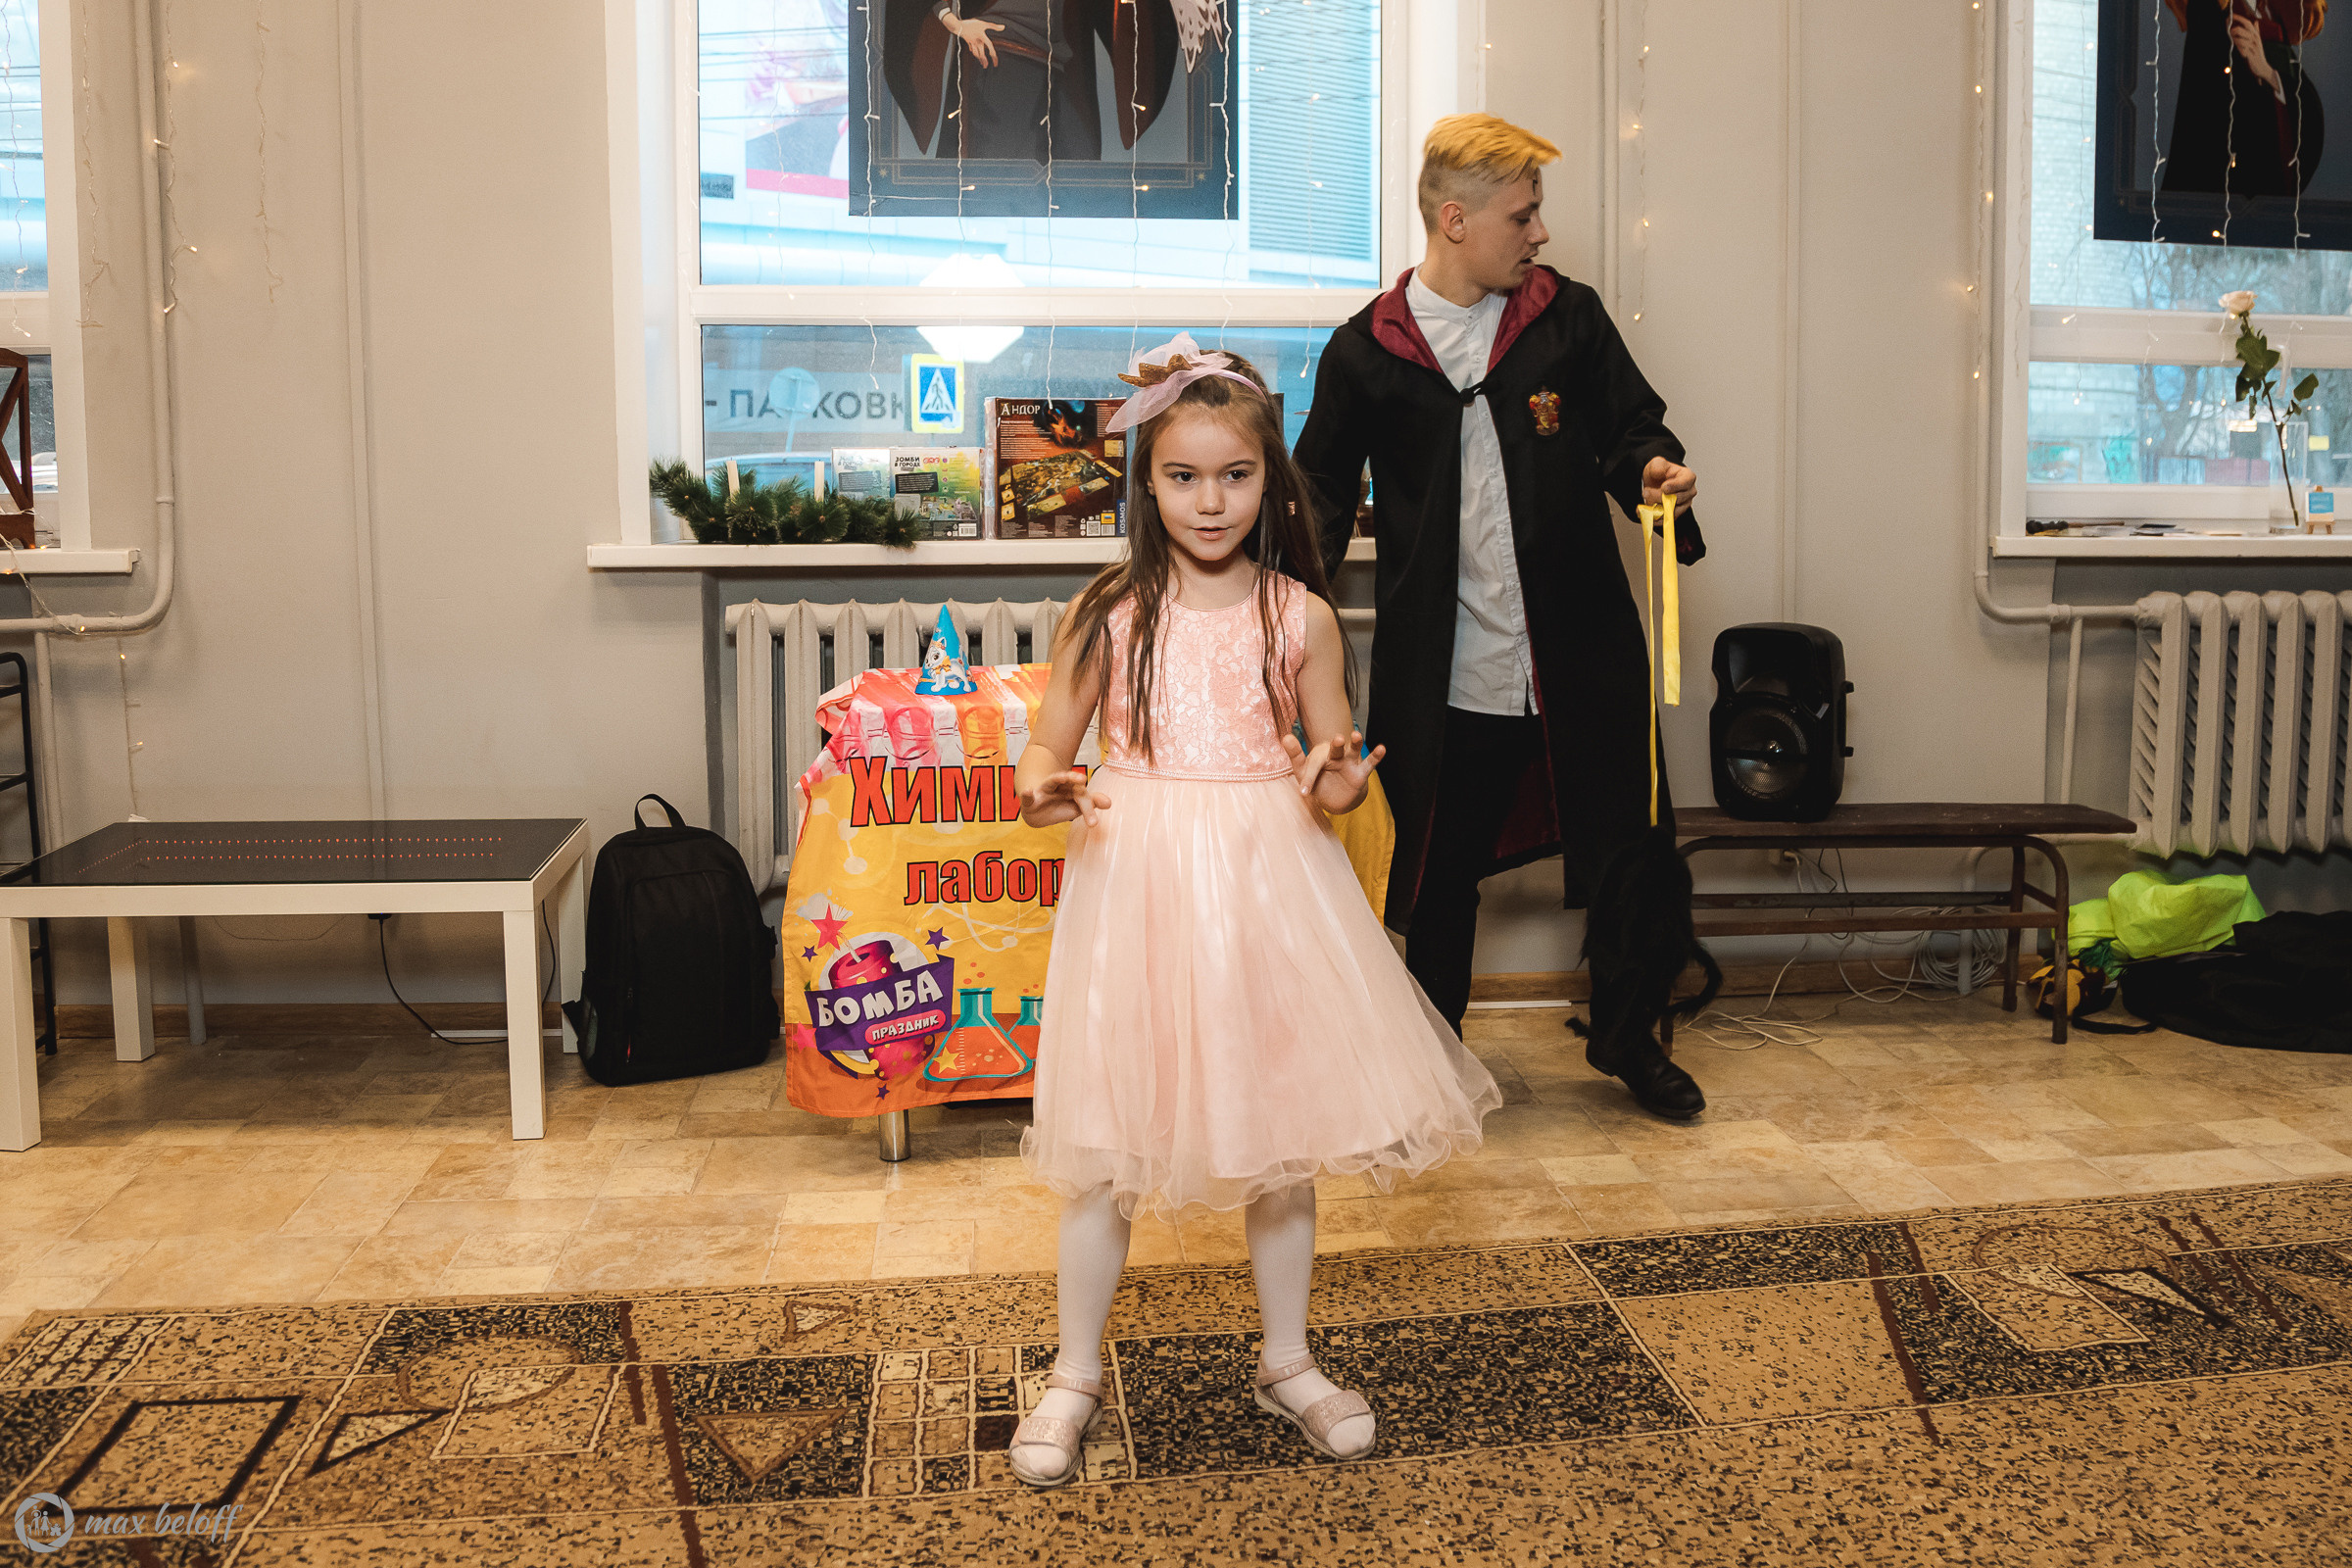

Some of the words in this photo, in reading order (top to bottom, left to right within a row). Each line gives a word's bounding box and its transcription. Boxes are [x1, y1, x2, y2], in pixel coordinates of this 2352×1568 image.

[730, 389, 904, 419] ПАКОВК
[1001, 403, 1041, 416] АНДОР
[816, 969, 944, 1027] БОМБА
[871, 1014, 939, 1042] ПРАЗДНИК
